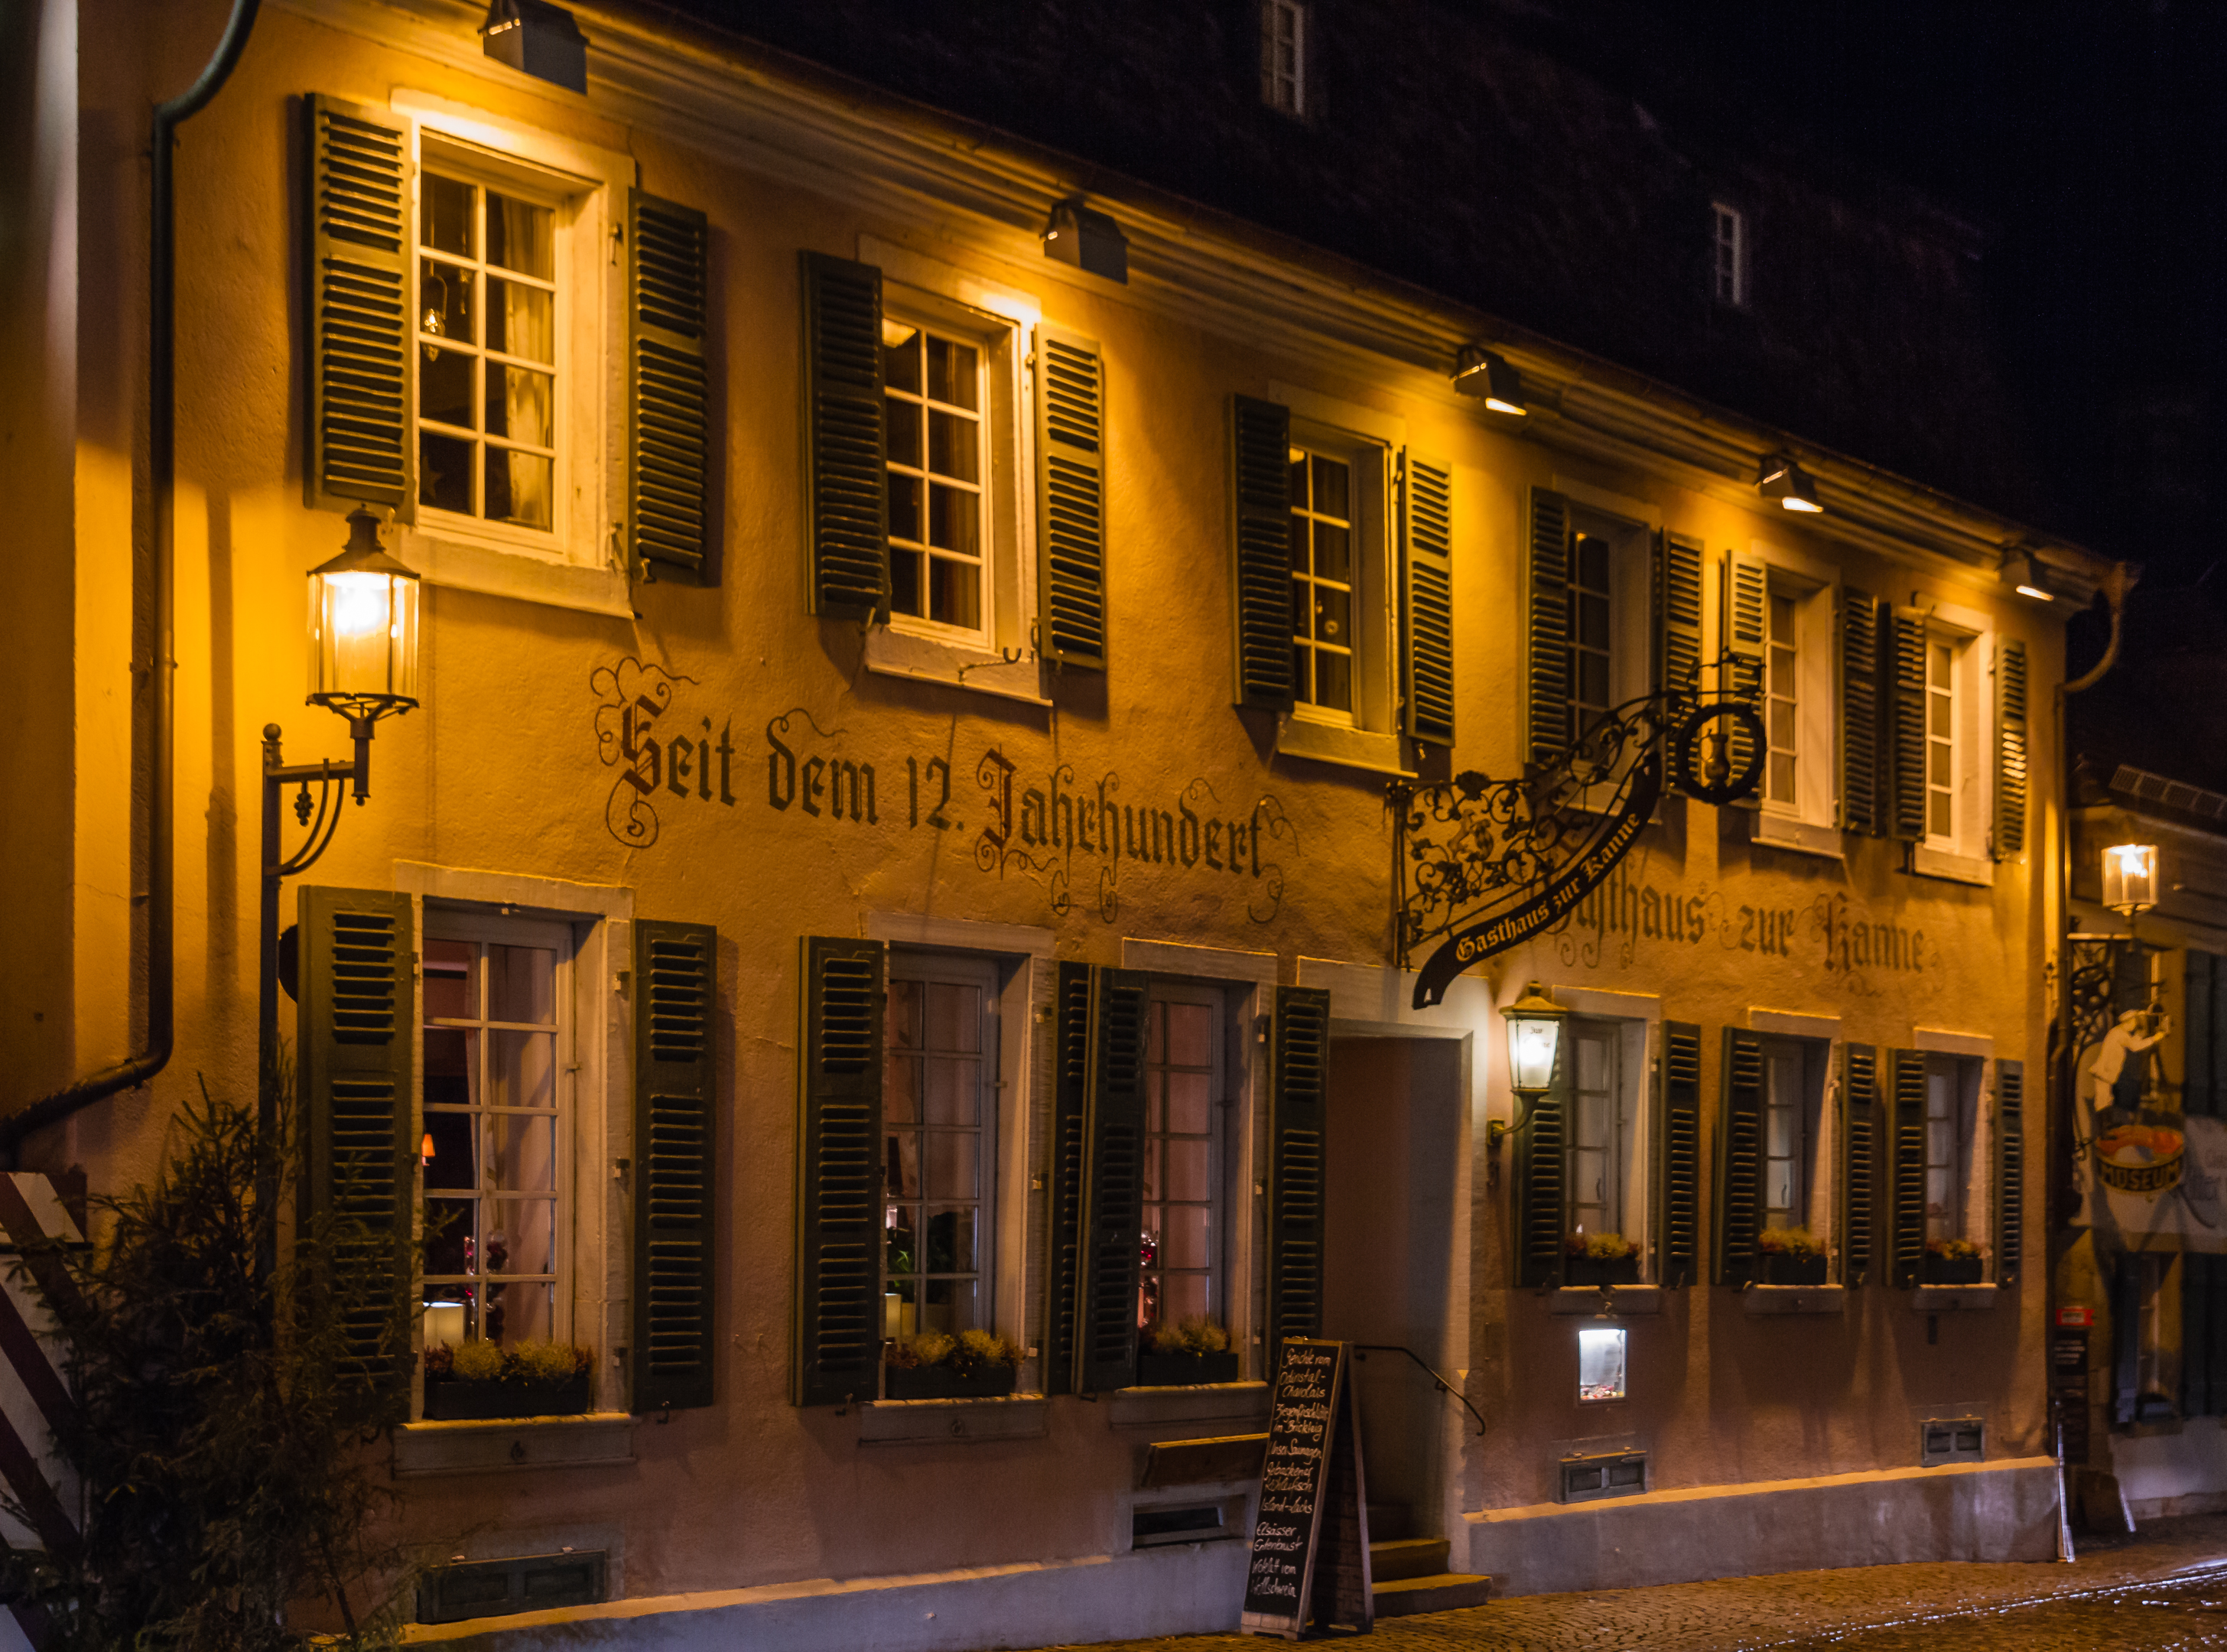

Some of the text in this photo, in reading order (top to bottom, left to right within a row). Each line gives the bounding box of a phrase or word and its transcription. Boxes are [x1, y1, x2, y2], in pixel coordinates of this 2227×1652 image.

[603, 673, 1286, 902] Seit dem 12. Jahrhundert
[1455, 812, 1640, 962] Gasthaus zur Kanne
[1539, 853, 1926, 983] asthaus zur Kanne
[2099, 1159, 2180, 1191] MUSEUM
